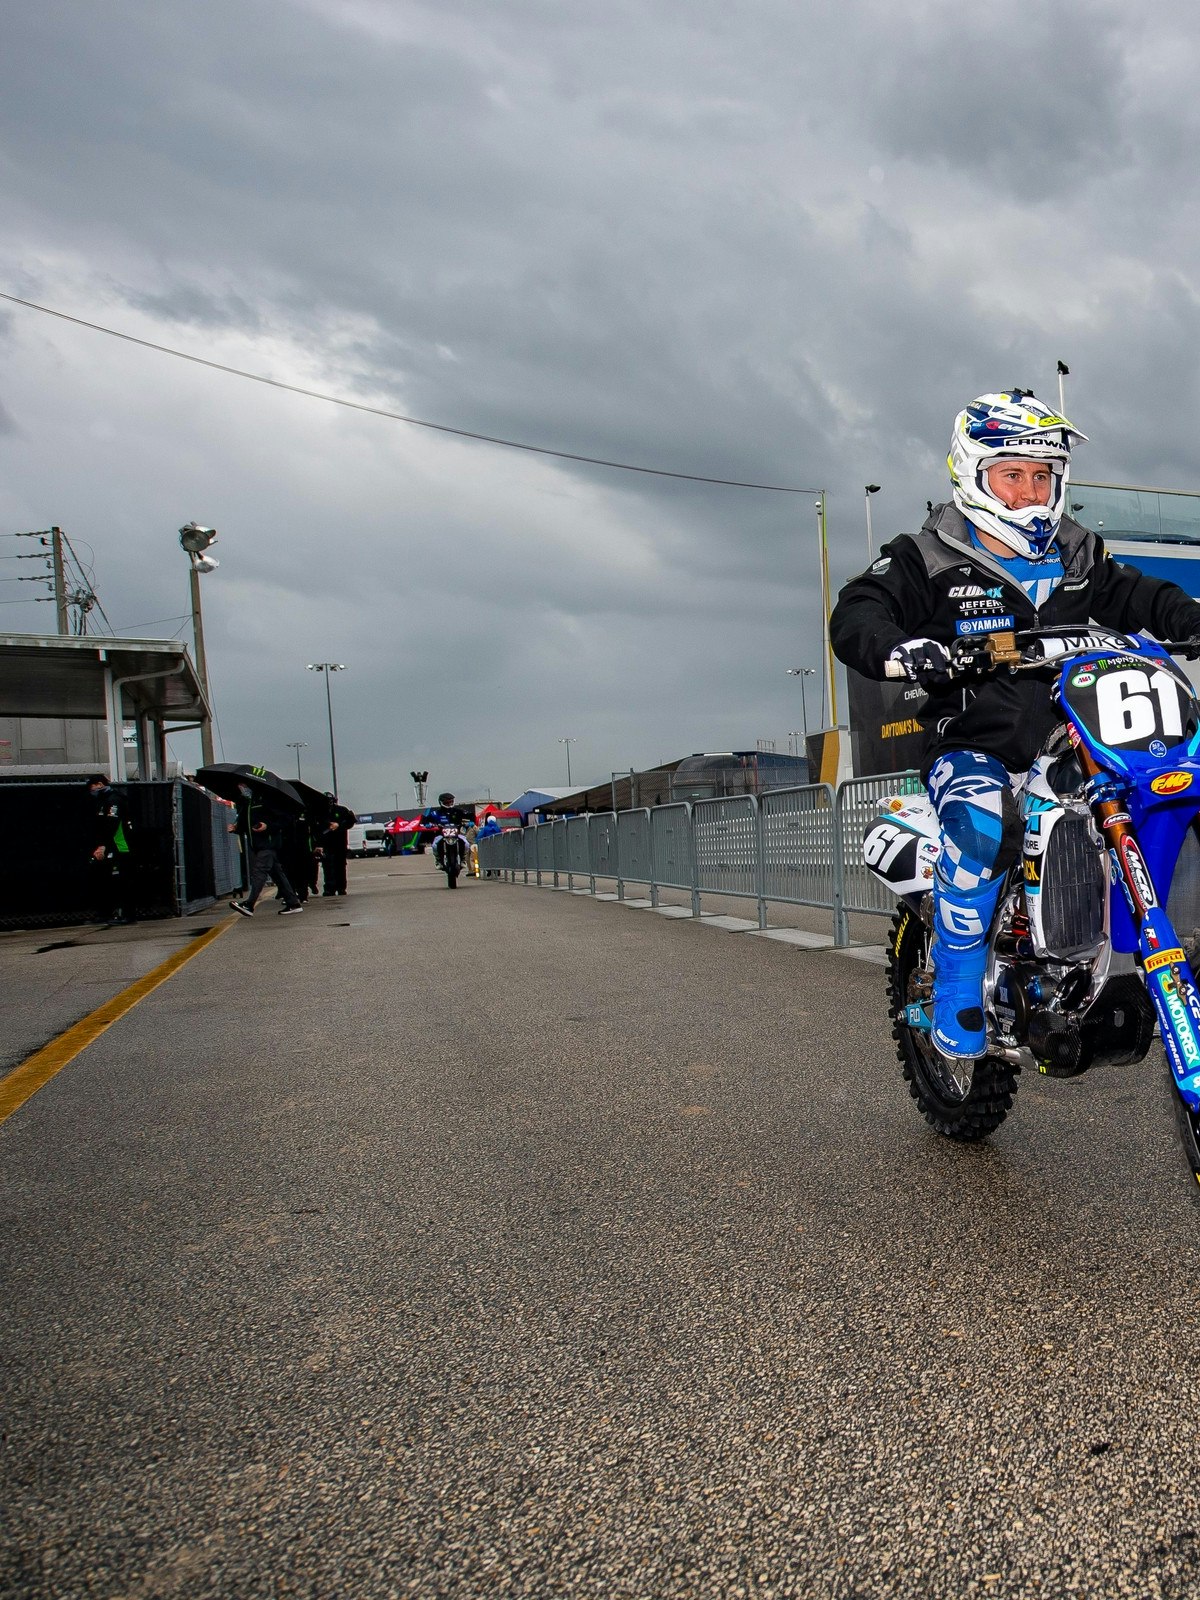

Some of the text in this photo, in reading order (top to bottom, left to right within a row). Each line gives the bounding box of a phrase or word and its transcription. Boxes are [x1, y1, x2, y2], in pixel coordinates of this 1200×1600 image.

[1005, 438, 1067, 451] CROWN
[964, 608, 1004, 616] HOMES
[972, 617, 1011, 631] YAMAHA
[1096, 669, 1183, 746] 61
[881, 719, 912, 739] DAYTONA'S
[1151, 773, 1194, 791] FMF
[863, 823, 917, 874] 61
[1128, 850, 1153, 905] MCR
[895, 912, 910, 958] PIRELLI
[1147, 951, 1185, 970] PIRELLI
[1166, 994, 1200, 1065] MOTOREX
